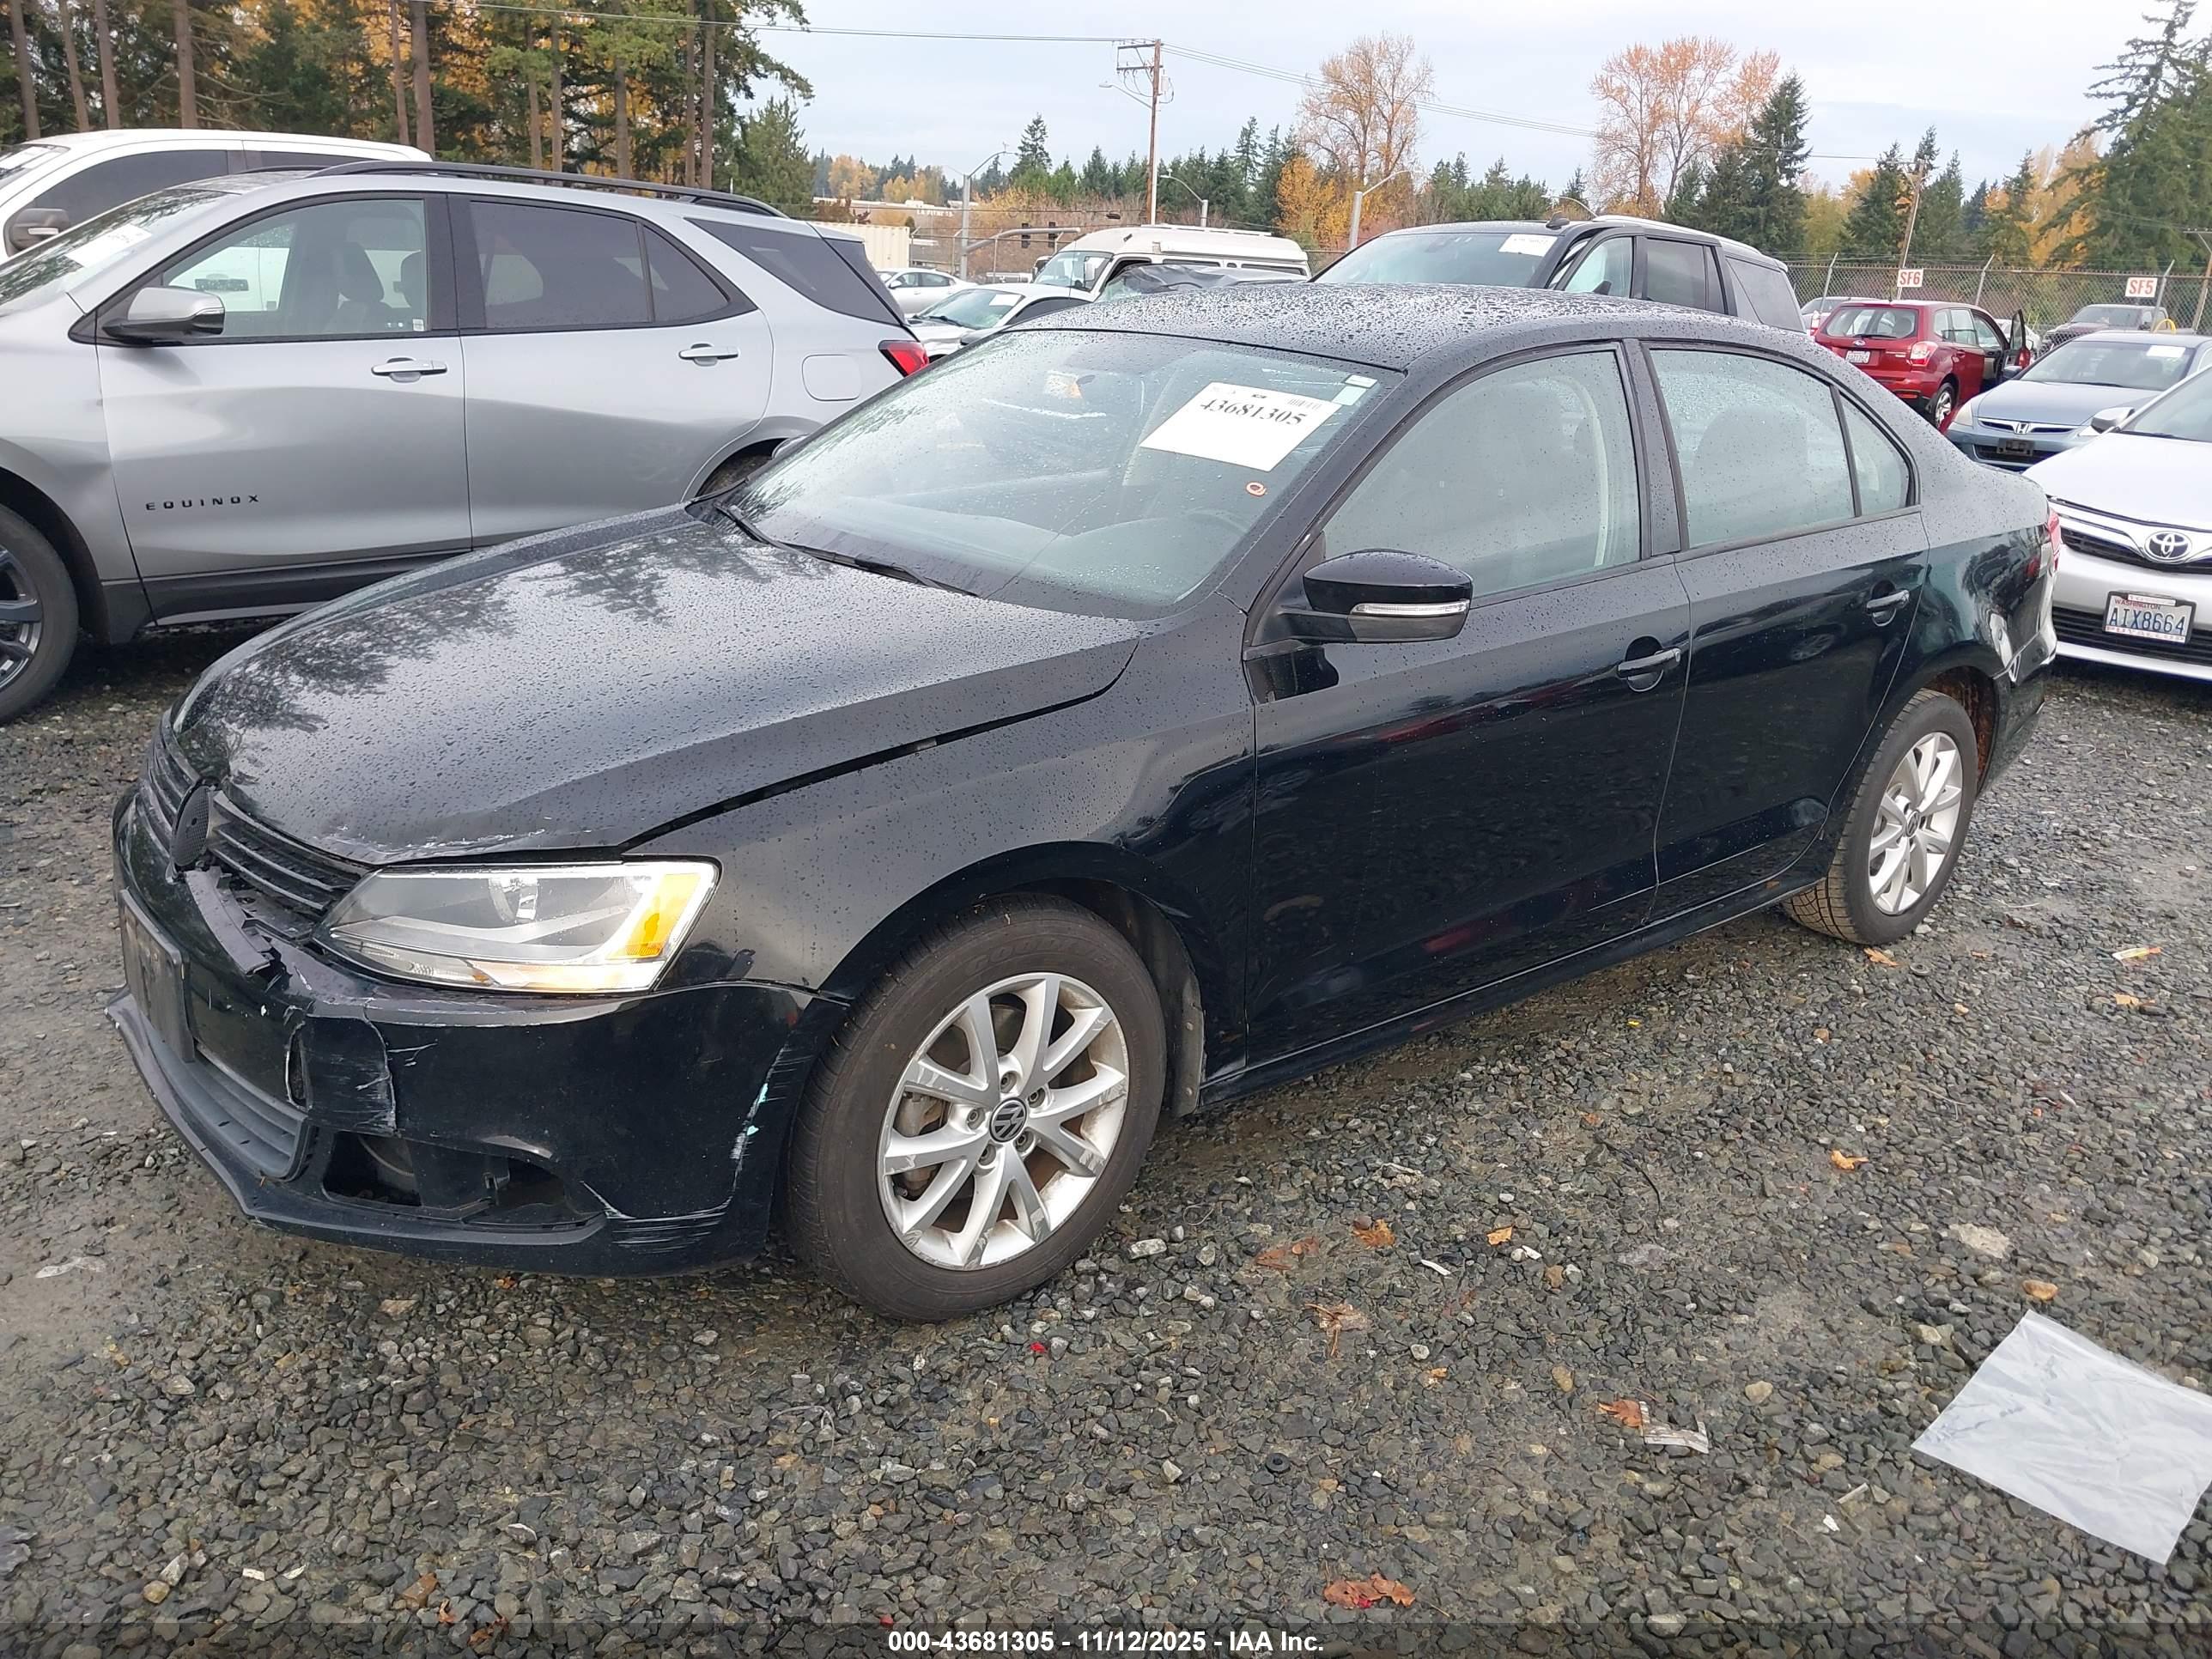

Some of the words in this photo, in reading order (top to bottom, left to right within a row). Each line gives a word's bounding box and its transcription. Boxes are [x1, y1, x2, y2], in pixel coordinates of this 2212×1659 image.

[1899, 271, 1921, 285] SF6
[2129, 279, 2154, 295] SF5
[1200, 398, 1308, 426] 43681305
[145, 495, 259, 511] EQUINOX
[2114, 599, 2161, 611] WASHINGTON
[2109, 607, 2185, 635] AIX8664
